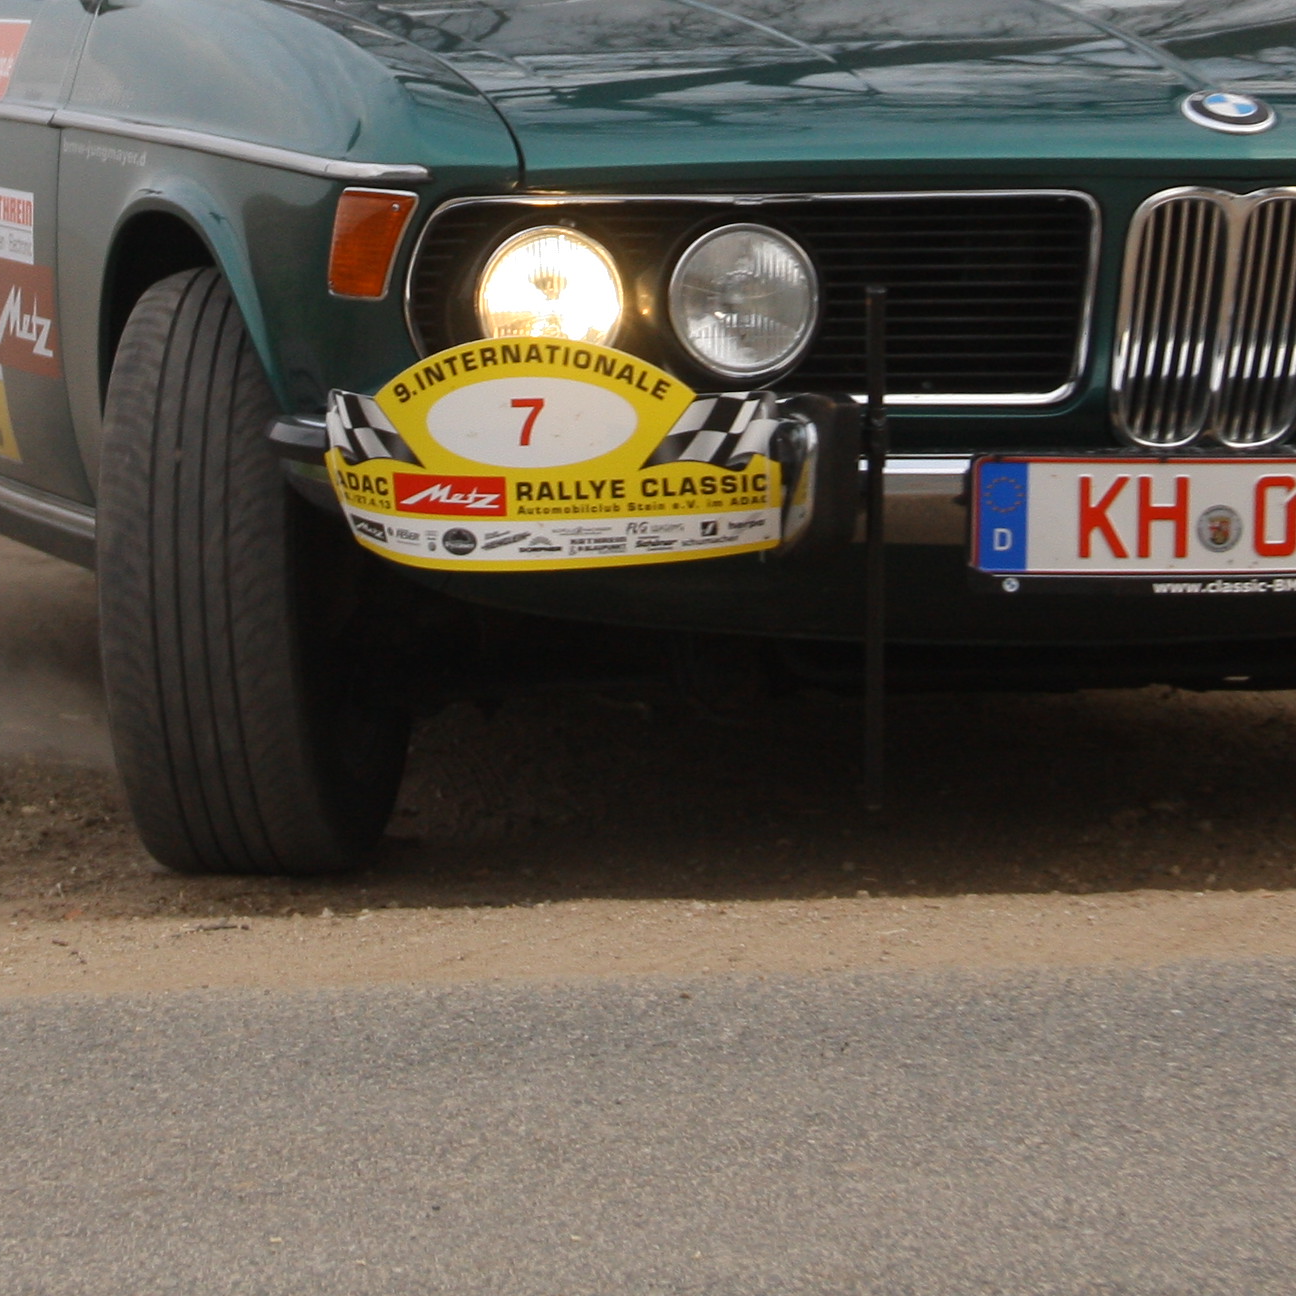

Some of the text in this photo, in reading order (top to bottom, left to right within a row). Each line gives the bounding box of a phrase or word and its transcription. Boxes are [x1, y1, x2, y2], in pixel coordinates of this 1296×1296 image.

[510, 398, 545, 446] 7
[400, 483, 502, 509] Metz
[515, 478, 626, 502] RALLYE
[642, 473, 768, 498] CLASSIC
[517, 502, 621, 515] Automobilclub
[1077, 475, 1191, 559] KH
[993, 528, 1012, 551] D
